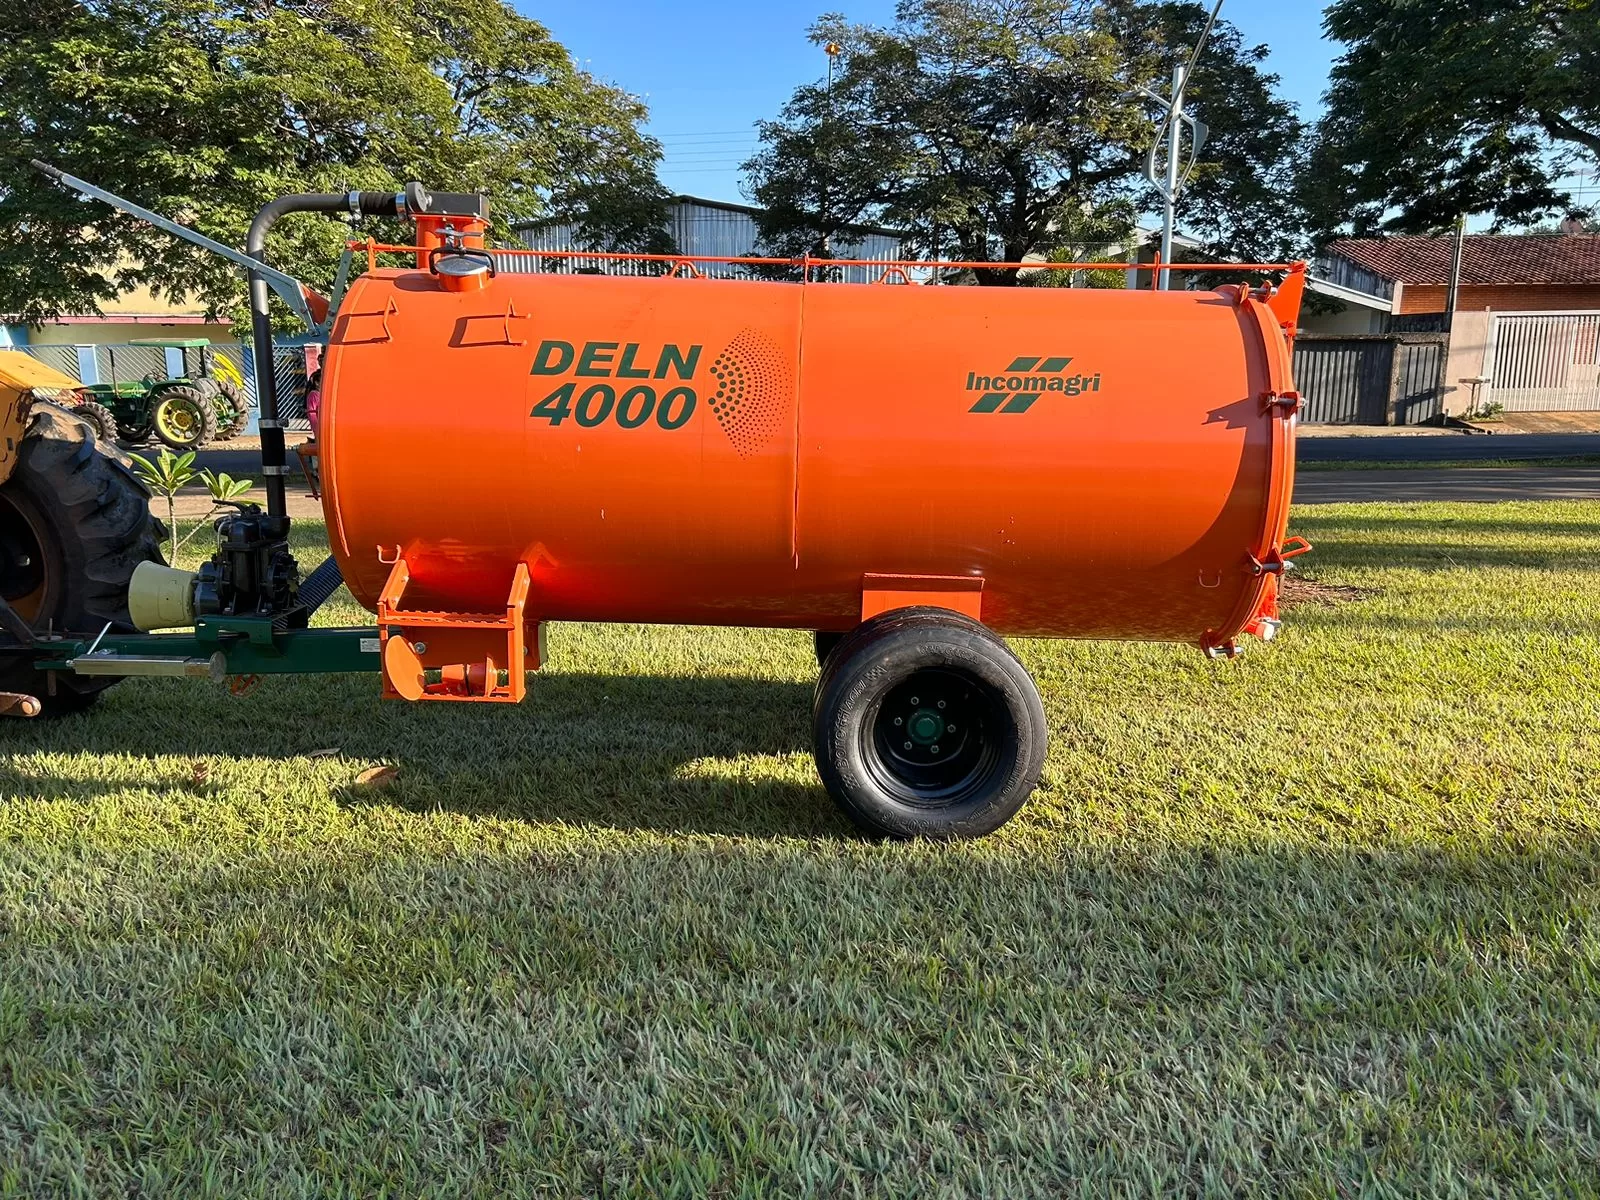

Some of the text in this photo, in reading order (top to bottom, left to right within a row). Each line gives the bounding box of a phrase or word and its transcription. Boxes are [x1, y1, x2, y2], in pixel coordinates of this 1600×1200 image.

[530, 340, 703, 380] DELN
[966, 372, 1101, 396] Incomagri
[530, 382, 697, 430] 4000
